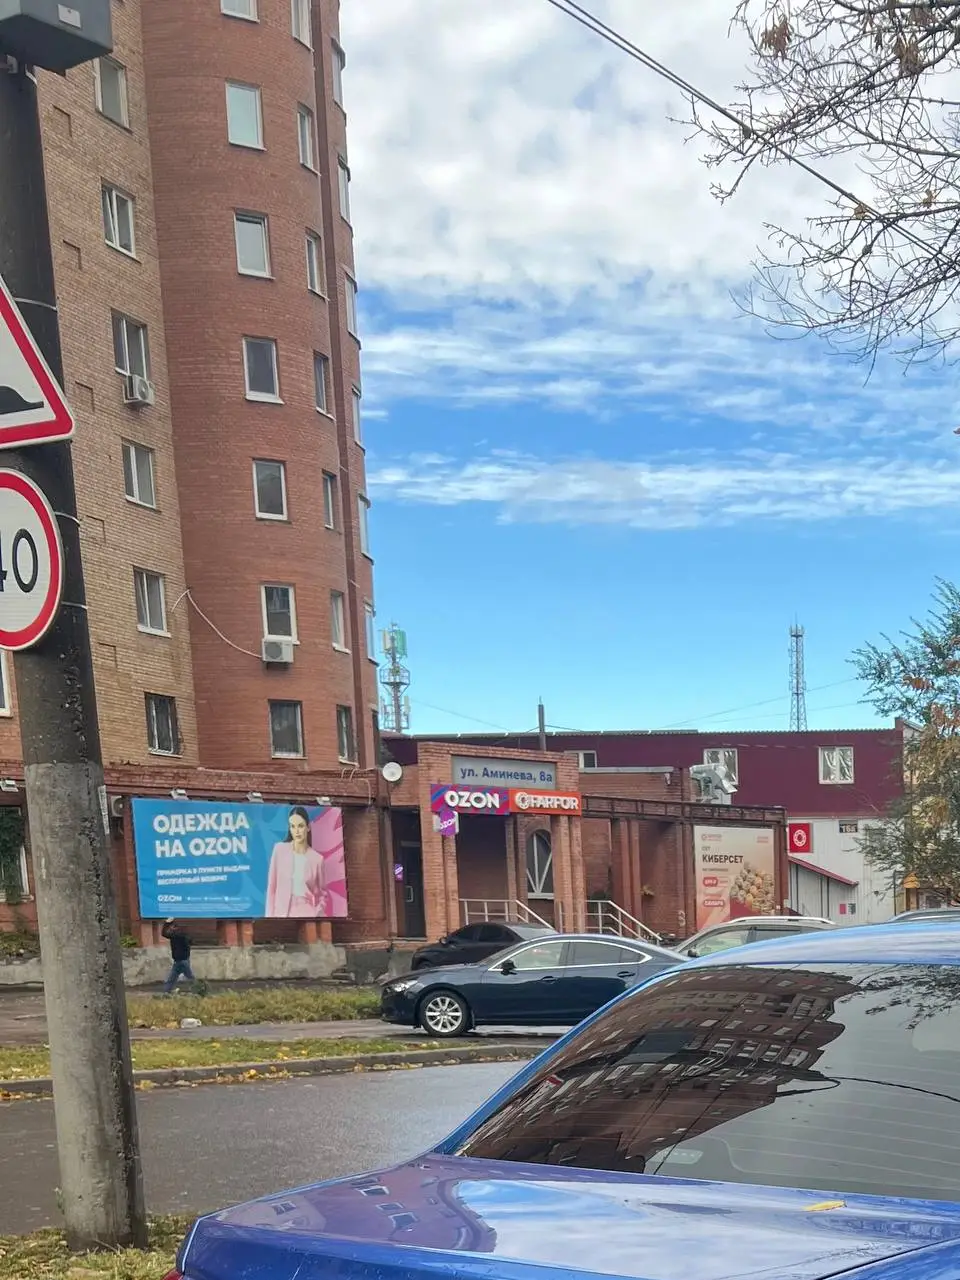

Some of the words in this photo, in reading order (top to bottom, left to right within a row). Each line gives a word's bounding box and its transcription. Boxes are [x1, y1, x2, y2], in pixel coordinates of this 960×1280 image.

[0, 529, 39, 593] 0
[460, 767, 478, 778] ул.
[482, 767, 537, 783] Аминева,
[539, 770, 553, 783] 8а
[444, 790, 499, 809] OZON
[531, 796, 579, 810] FARFOR
[153, 812, 250, 836] ОДЕЖДА
[155, 840, 186, 858] НА
[189, 836, 248, 857] OZON
[702, 854, 744, 864] КИБЕРСЕТ
